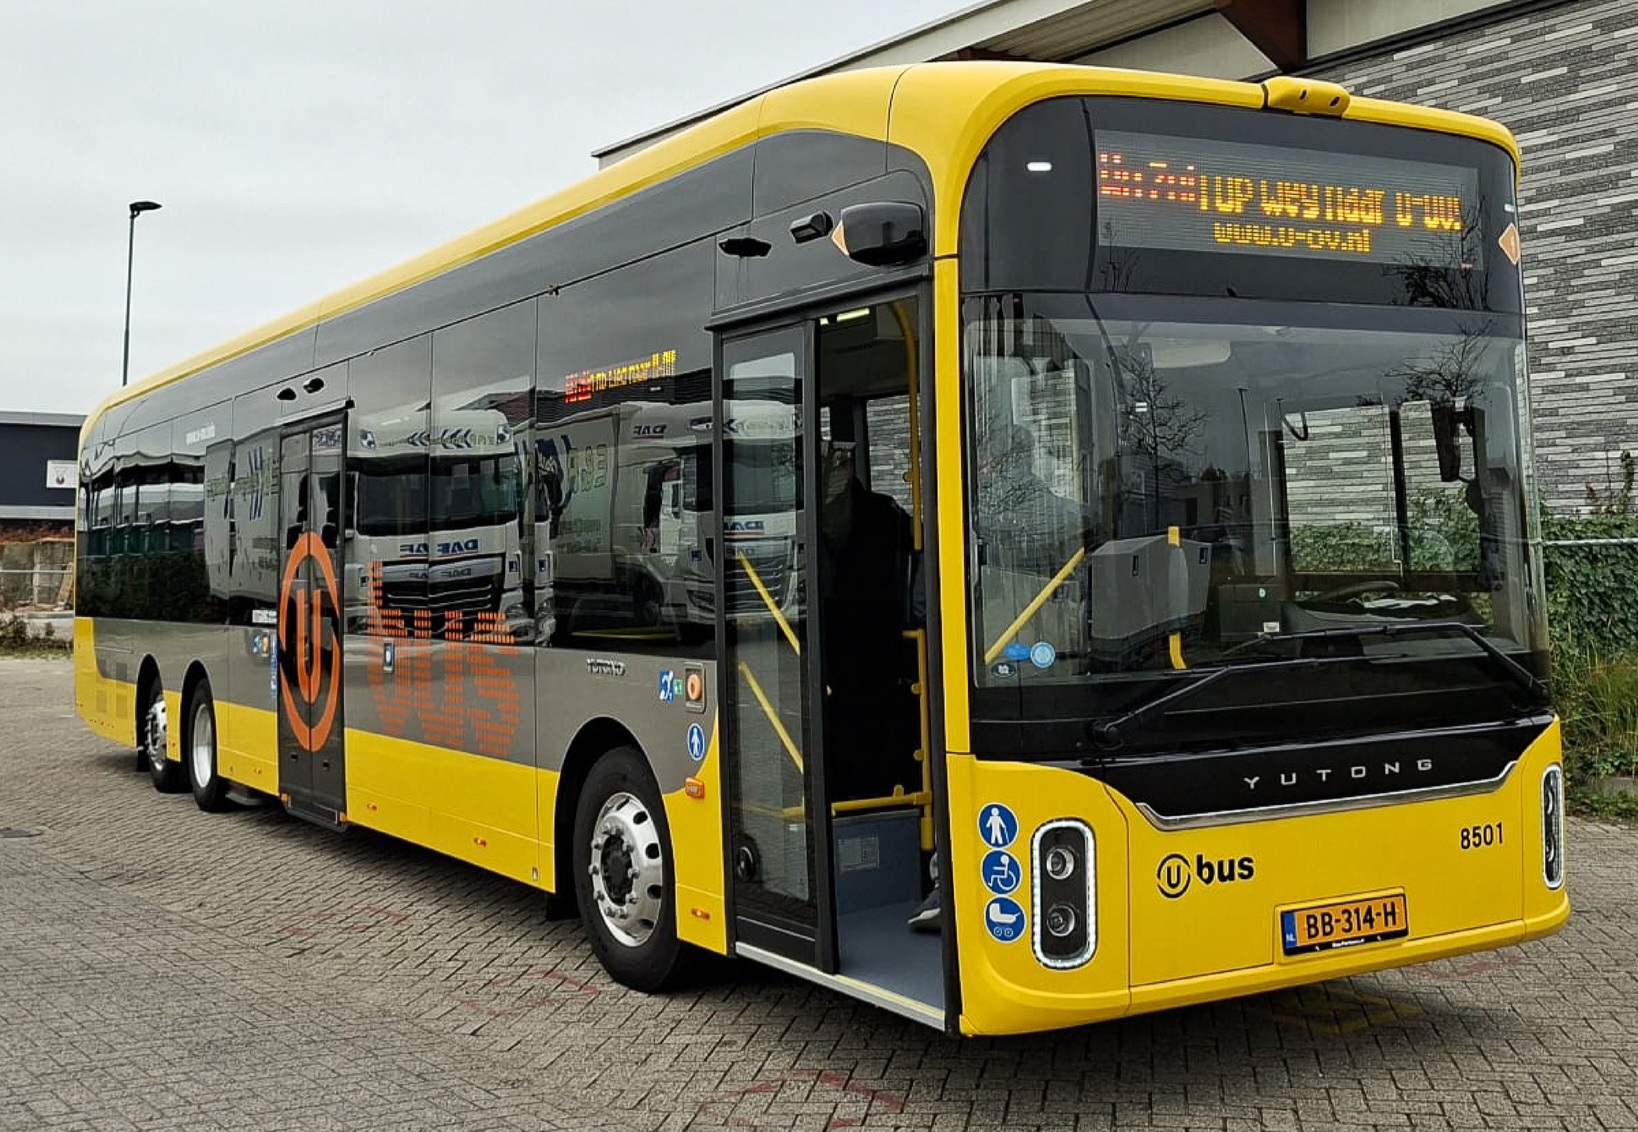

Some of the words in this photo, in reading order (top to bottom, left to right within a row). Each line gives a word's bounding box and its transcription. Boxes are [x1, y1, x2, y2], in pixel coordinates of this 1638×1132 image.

[366, 560, 520, 757] bus
[1243, 758, 1433, 790] YUTONG
[1460, 821, 1503, 850] 8501
[1196, 853, 1254, 885] bus
[1306, 901, 1398, 939] BB-314-H
